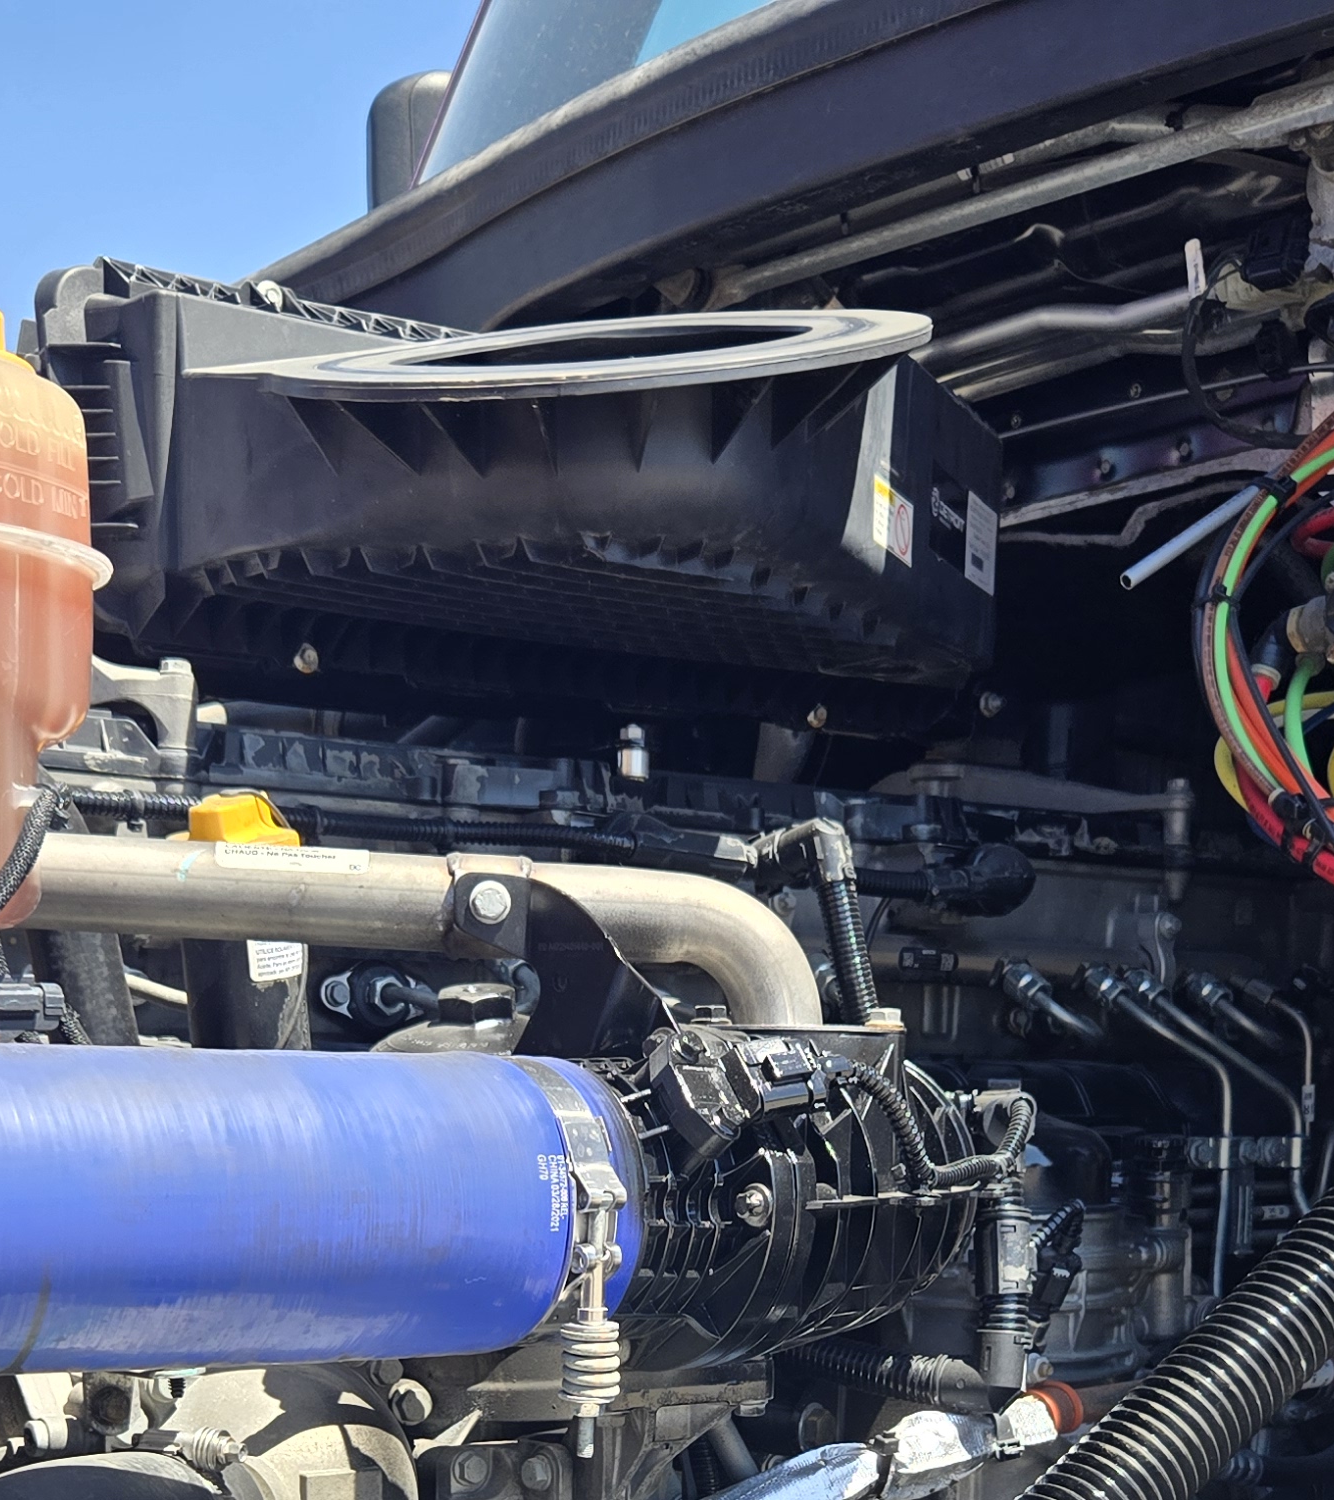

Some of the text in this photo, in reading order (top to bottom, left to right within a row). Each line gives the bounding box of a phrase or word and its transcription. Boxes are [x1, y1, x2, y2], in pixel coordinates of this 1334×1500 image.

[48, 437, 76, 471] FILL
[537, 1154, 549, 1181] GH70
[548, 1154, 560, 1184] CHINA
